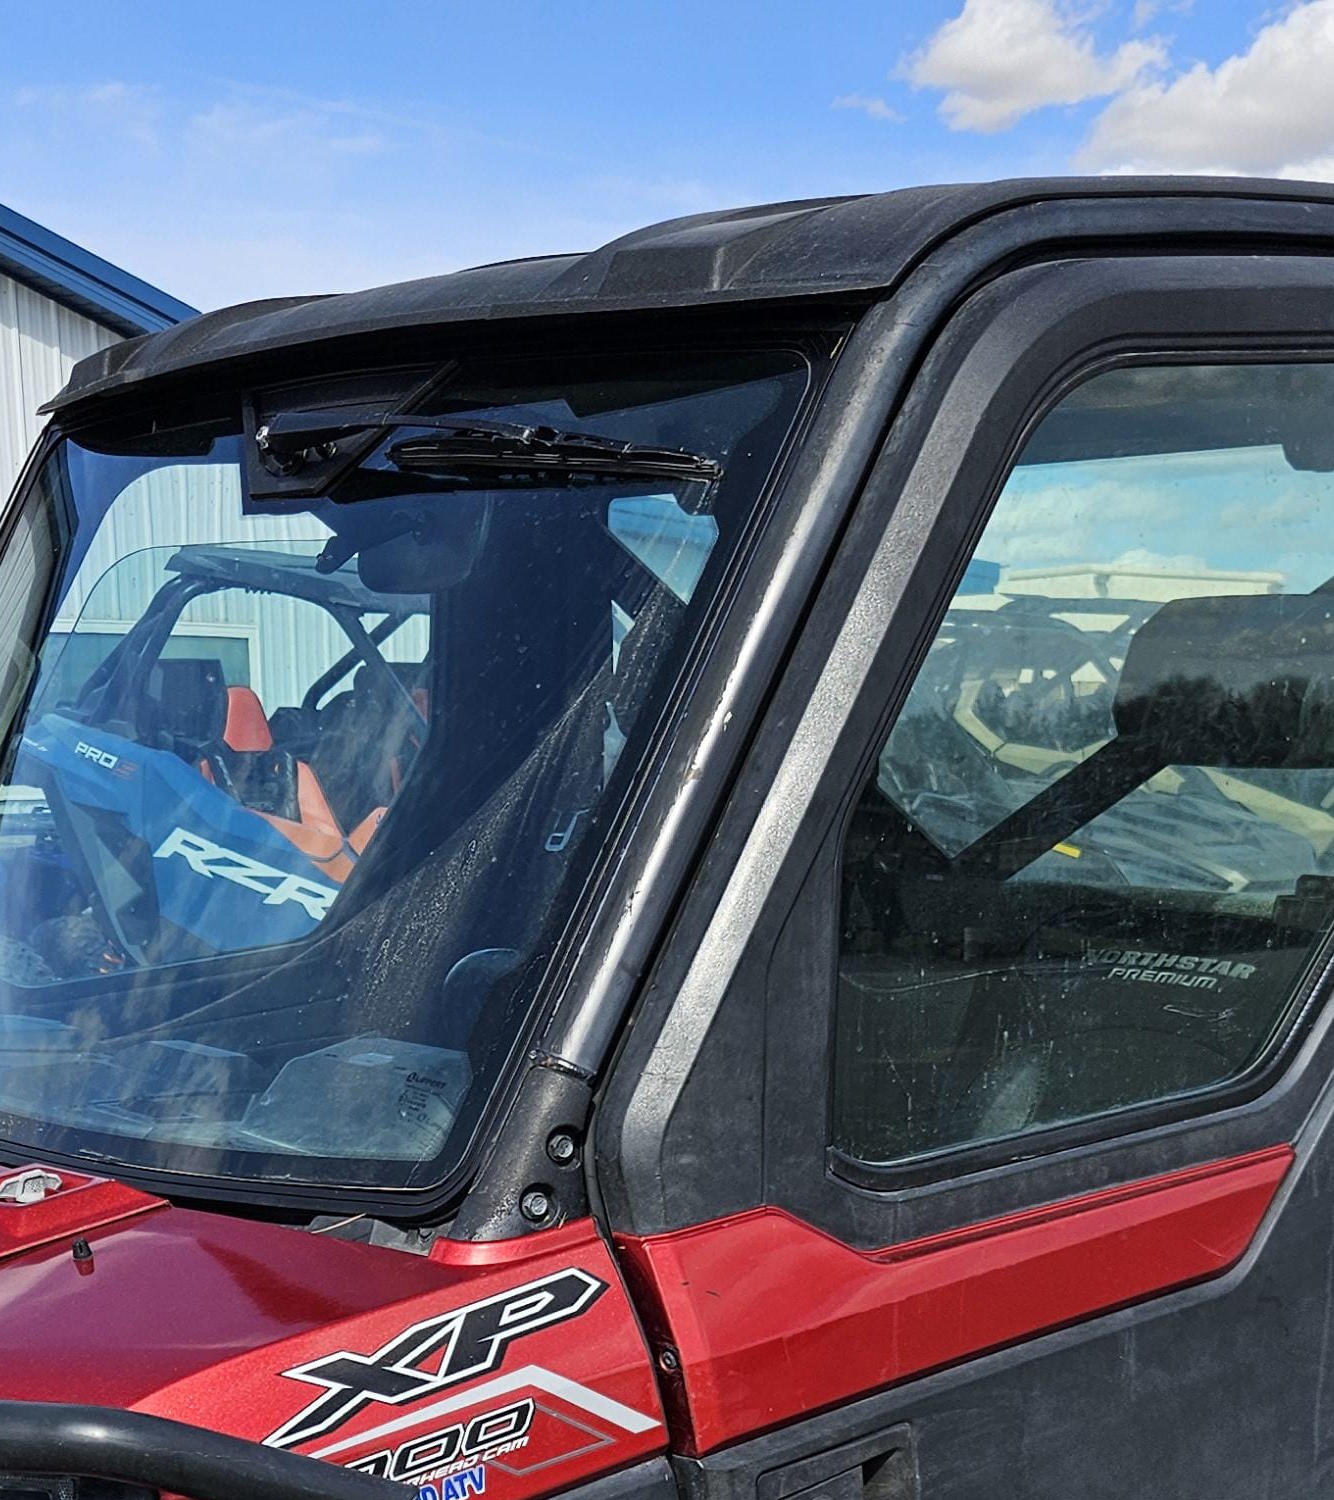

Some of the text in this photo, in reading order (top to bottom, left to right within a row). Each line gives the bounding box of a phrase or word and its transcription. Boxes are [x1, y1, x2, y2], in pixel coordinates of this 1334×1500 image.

[74, 741, 119, 770] PRO
[153, 827, 340, 921] RZR
[1107, 967, 1218, 989] PREMIUM
[261, 1266, 610, 1450] XP
[483, 1436, 529, 1463] CAM
